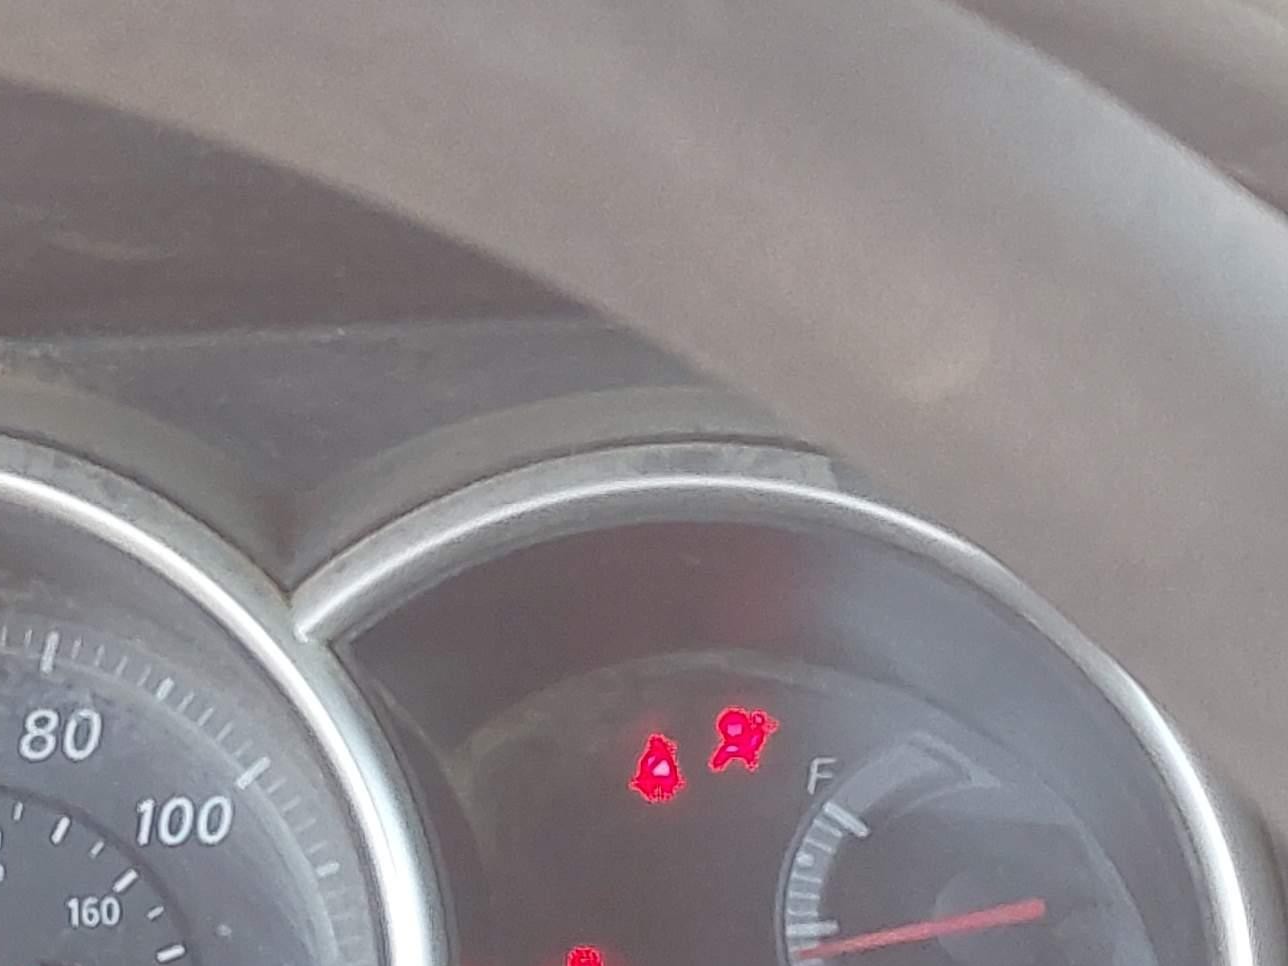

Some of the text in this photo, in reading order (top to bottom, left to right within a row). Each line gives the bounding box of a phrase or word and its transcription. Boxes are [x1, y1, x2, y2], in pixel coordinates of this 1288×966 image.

[17, 708, 103, 761] 80
[808, 756, 837, 795] F
[135, 796, 234, 846] 100
[66, 898, 120, 929] 160
